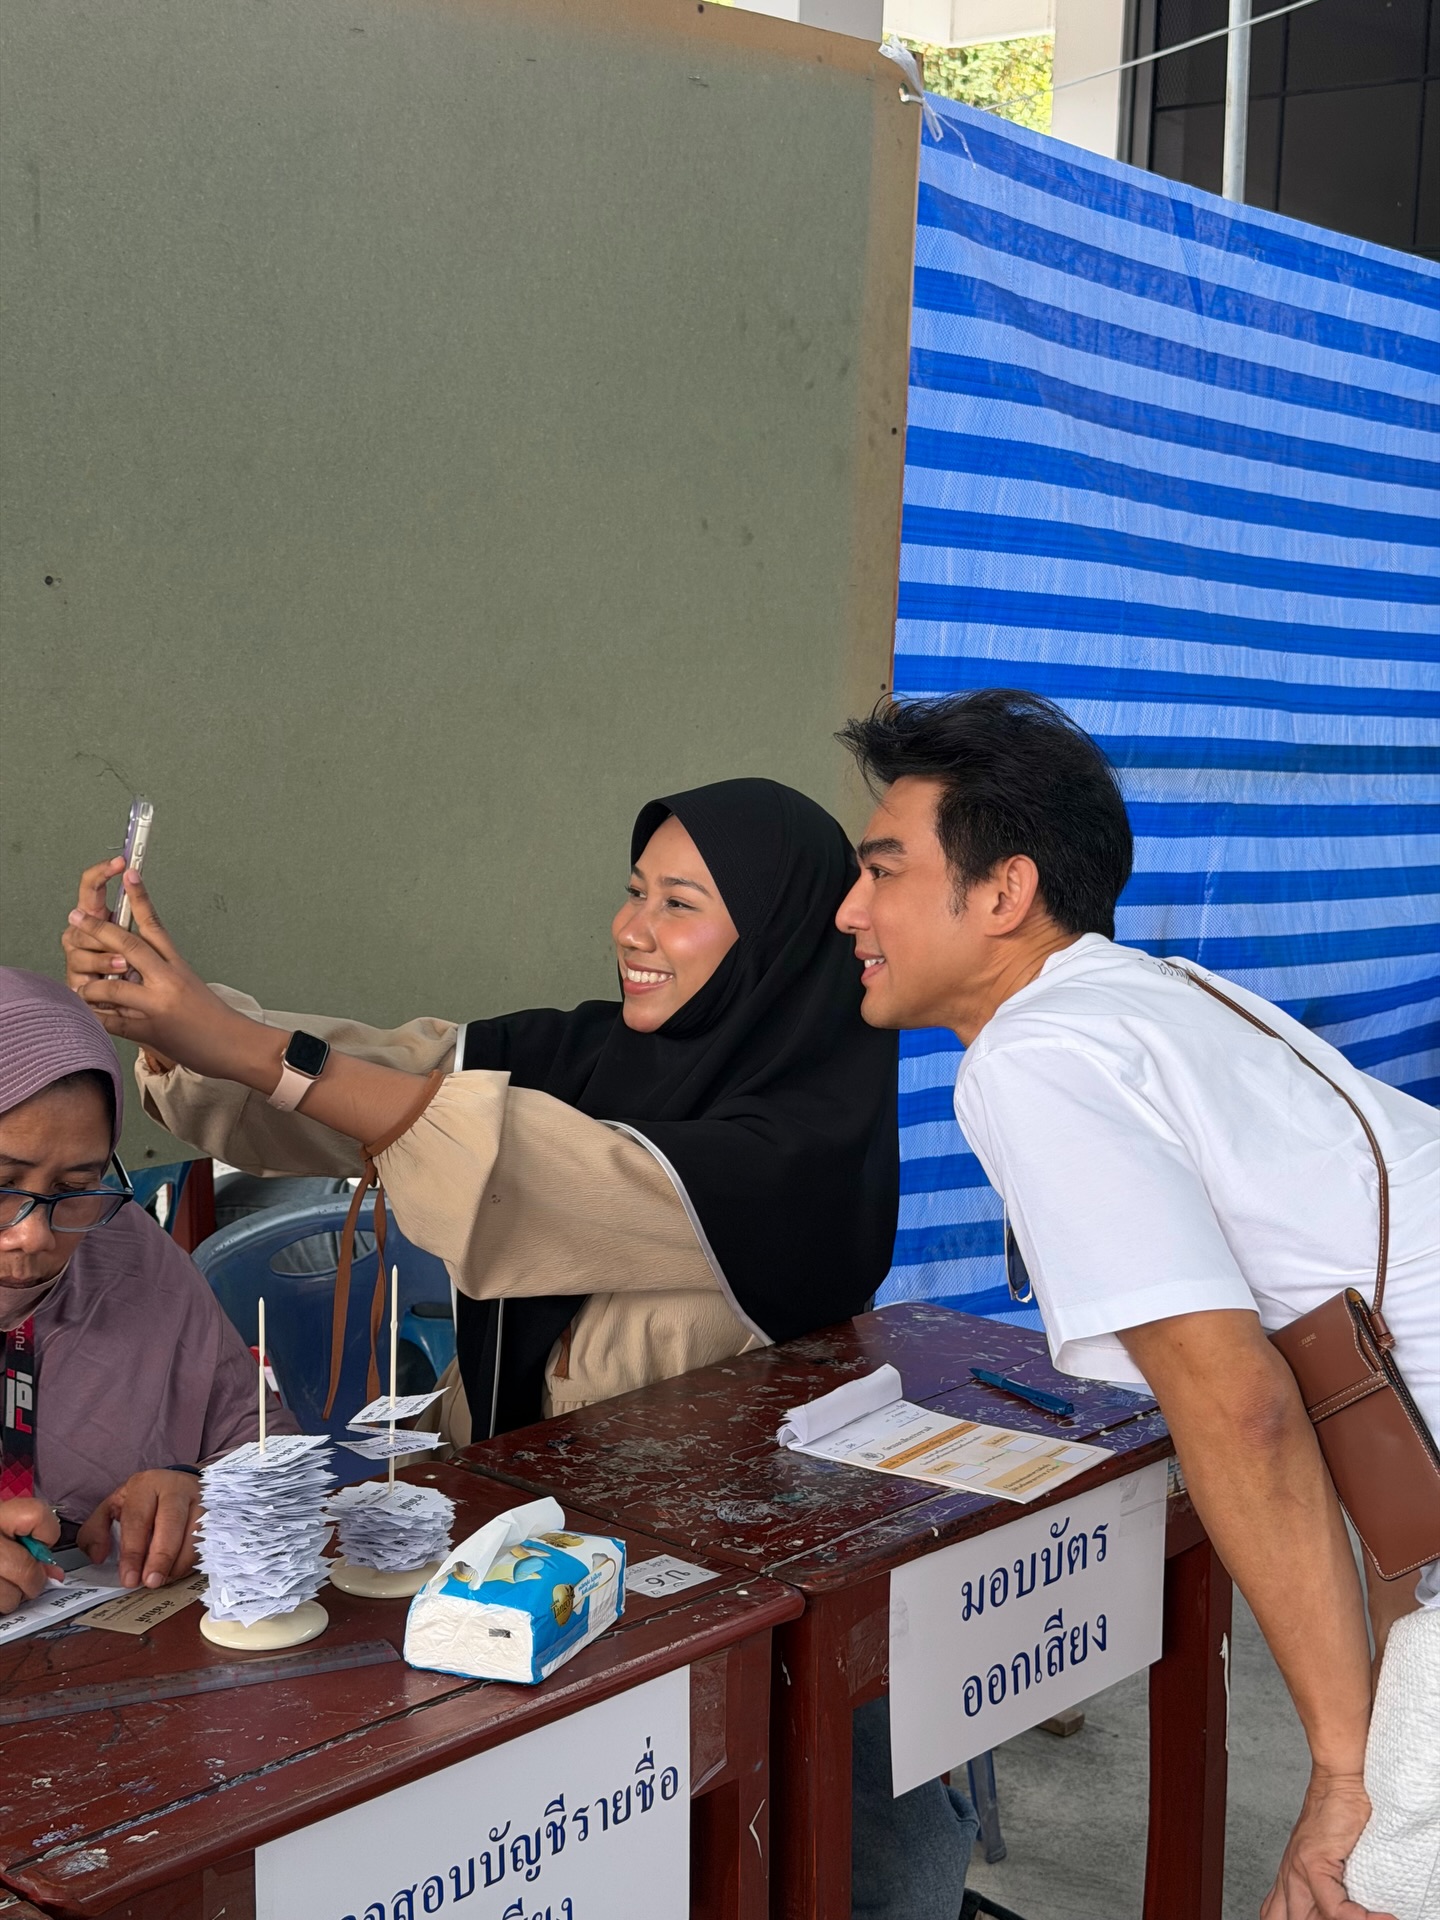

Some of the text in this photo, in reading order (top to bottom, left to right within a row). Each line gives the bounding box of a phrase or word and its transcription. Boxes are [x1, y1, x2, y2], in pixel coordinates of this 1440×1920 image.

[961, 1516, 1109, 1622] มอบบัตร
[961, 1607, 1108, 1718] ออกเสียง
